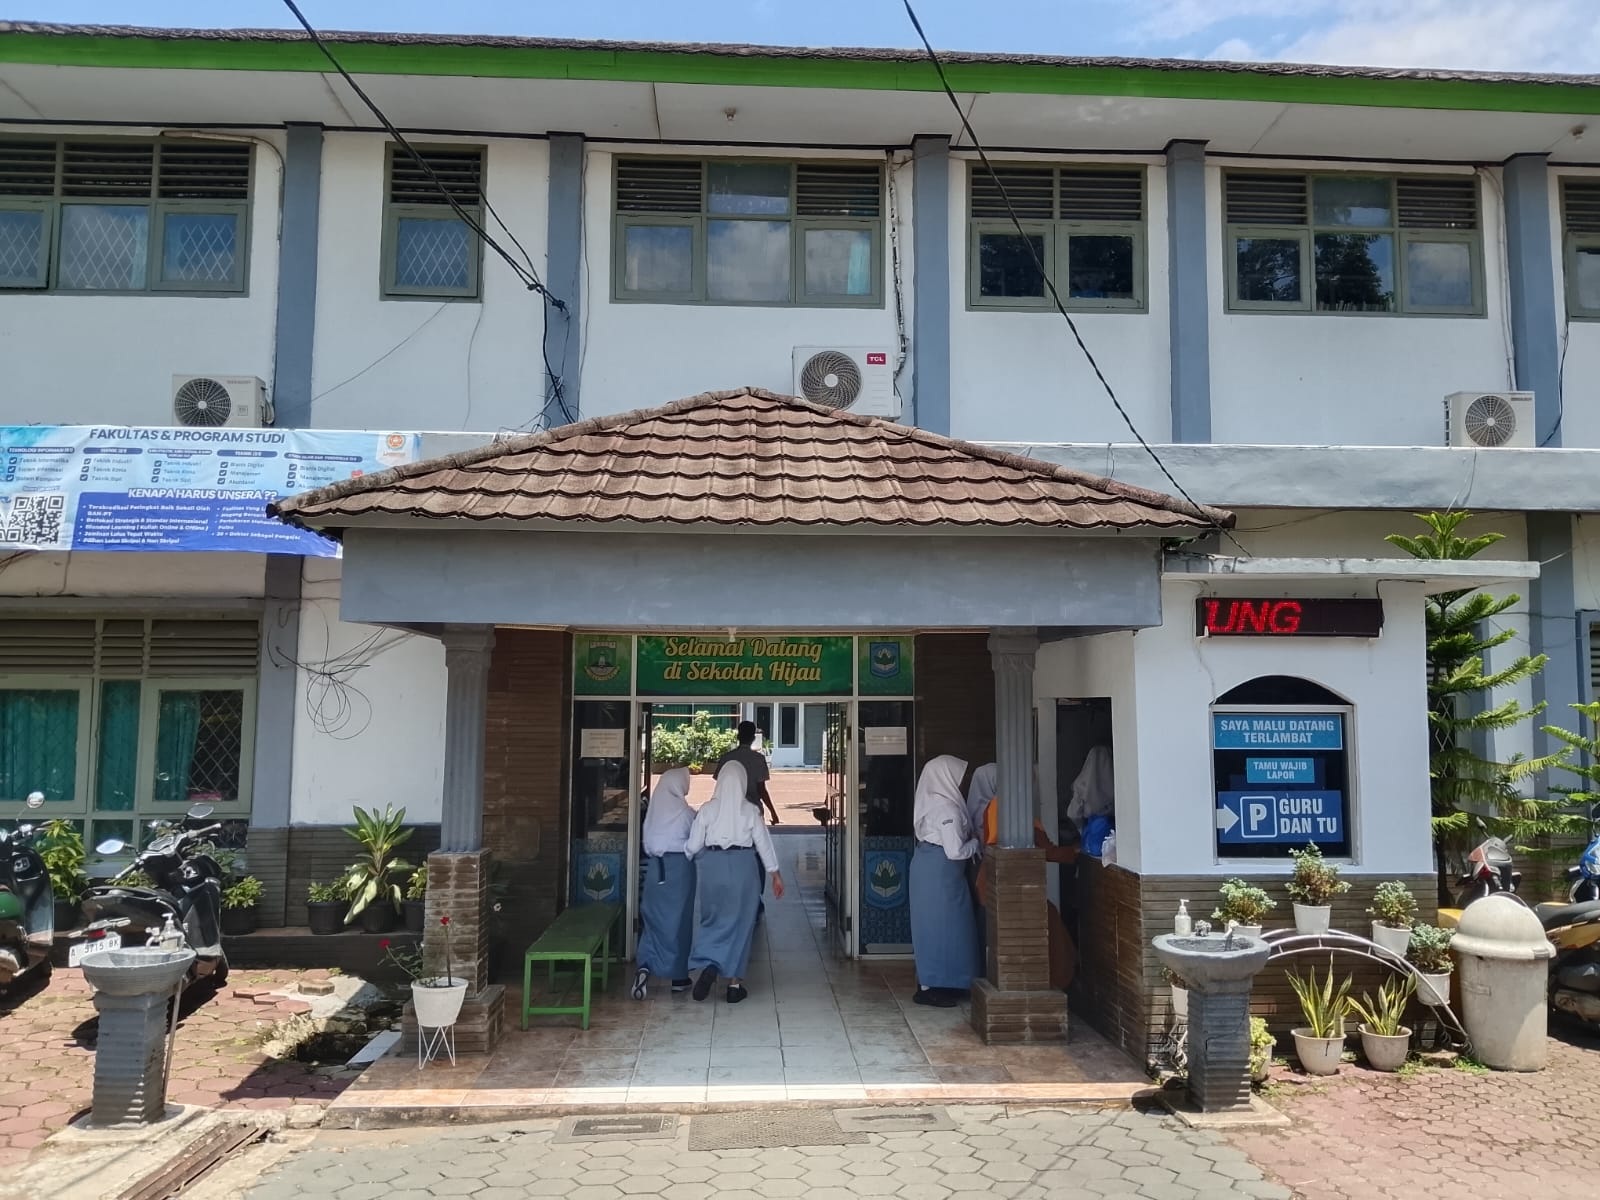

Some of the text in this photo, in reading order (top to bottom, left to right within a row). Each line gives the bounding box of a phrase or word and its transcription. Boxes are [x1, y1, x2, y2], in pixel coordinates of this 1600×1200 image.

[89, 428, 285, 444] FAKULTAS & PROGRAM STUDI
[127, 488, 174, 498] KENAPA
[176, 489, 216, 499] HARUS
[217, 490, 263, 501] UNSERA
[665, 637, 822, 663] Selamat Datang
[663, 661, 821, 687] di Sekolah Hijau
[1221, 720, 1335, 731] SAYA MALU DATANG
[1243, 732, 1313, 744] TERLAMBAT
[1253, 761, 1307, 770] TAMU WAJIB
[1266, 771, 1295, 779] LAPOR
[1279, 798, 1322, 815] GURU
[1249, 803, 1268, 831] P
[1280, 817, 1337, 834] DAN TU
